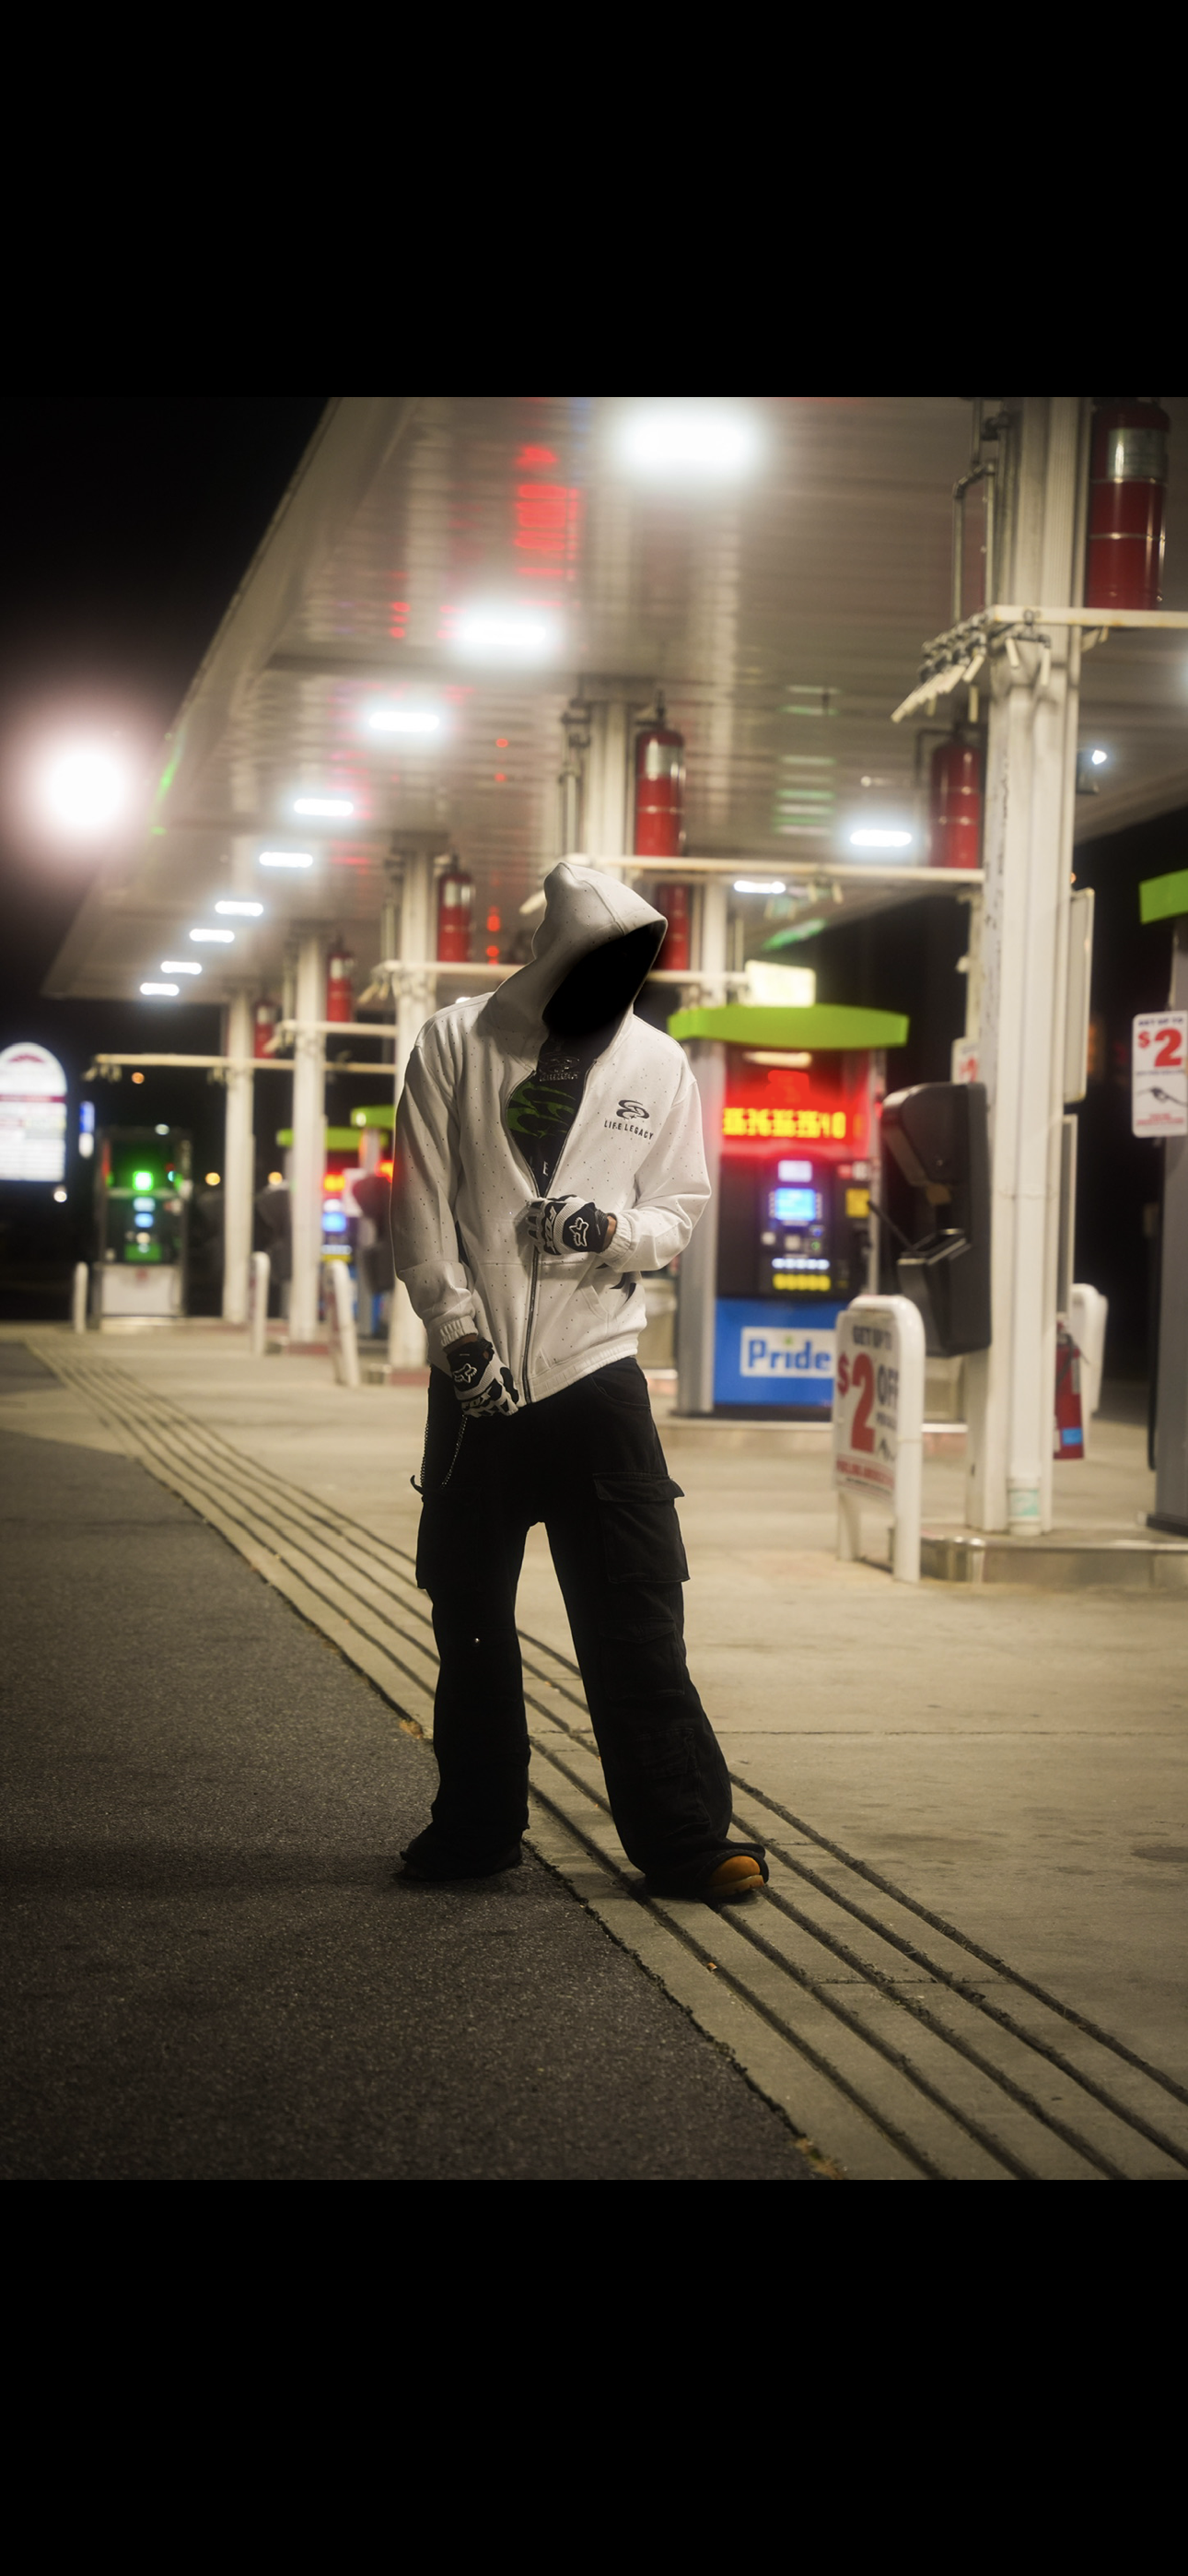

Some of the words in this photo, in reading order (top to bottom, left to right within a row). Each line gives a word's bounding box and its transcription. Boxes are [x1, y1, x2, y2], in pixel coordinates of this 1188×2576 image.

[1138, 1027, 1182, 1067] $2
[603, 1119, 622, 1130] LIFE
[624, 1123, 654, 1141] LEGACY
[748, 1336, 832, 1371] Pride
[837, 1352, 875, 1454] $2
